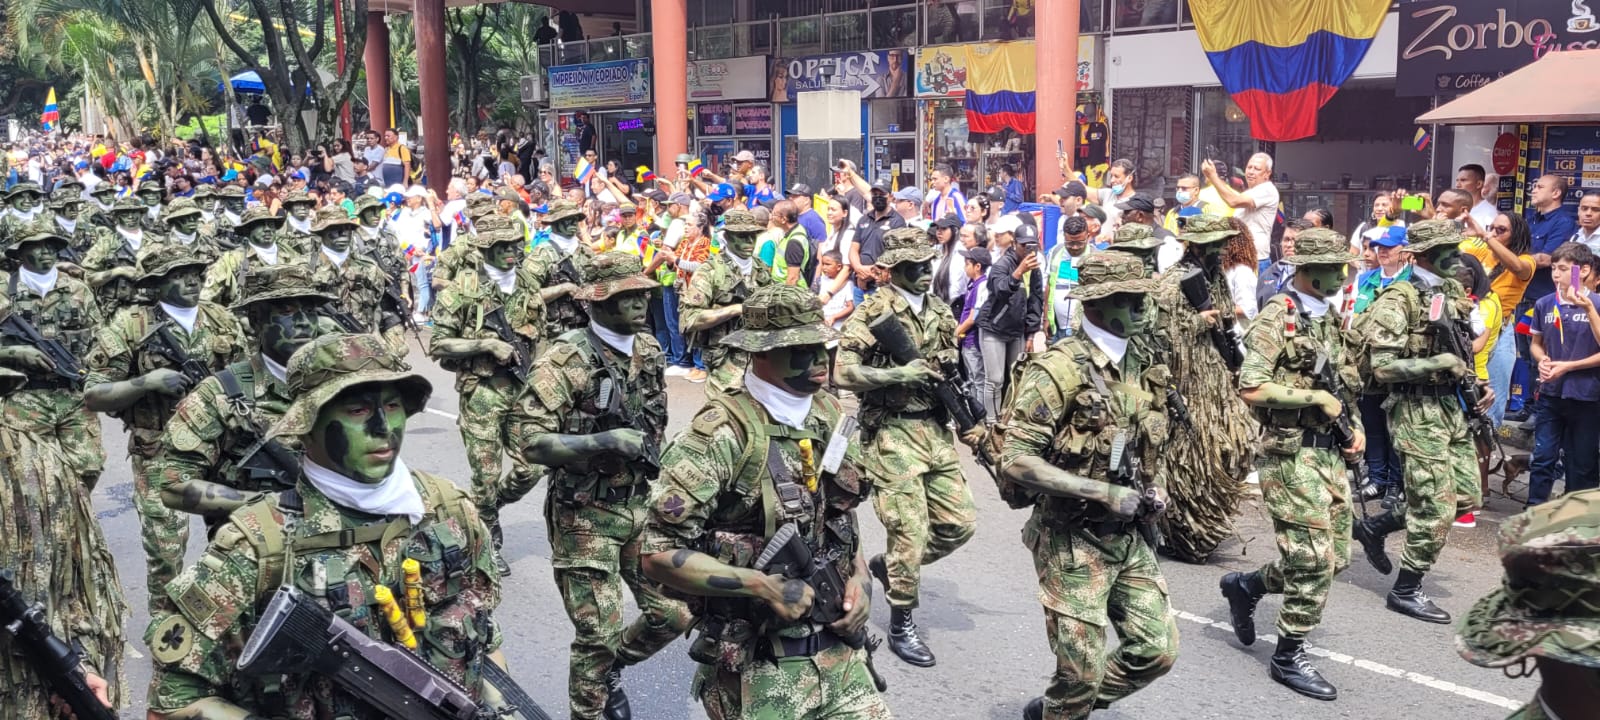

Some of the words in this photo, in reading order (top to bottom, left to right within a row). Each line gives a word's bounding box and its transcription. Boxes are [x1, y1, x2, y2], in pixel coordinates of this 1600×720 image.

[1402, 5, 1552, 60] Zorbo
[552, 67, 588, 86] IMPRESIÓN
[595, 66, 628, 82] COPIADO
[1455, 74, 1490, 88] Coffee
[713, 115, 718, 125] 5
[1494, 147, 1511, 157] Claro
[1555, 160, 1576, 170] 1GB
